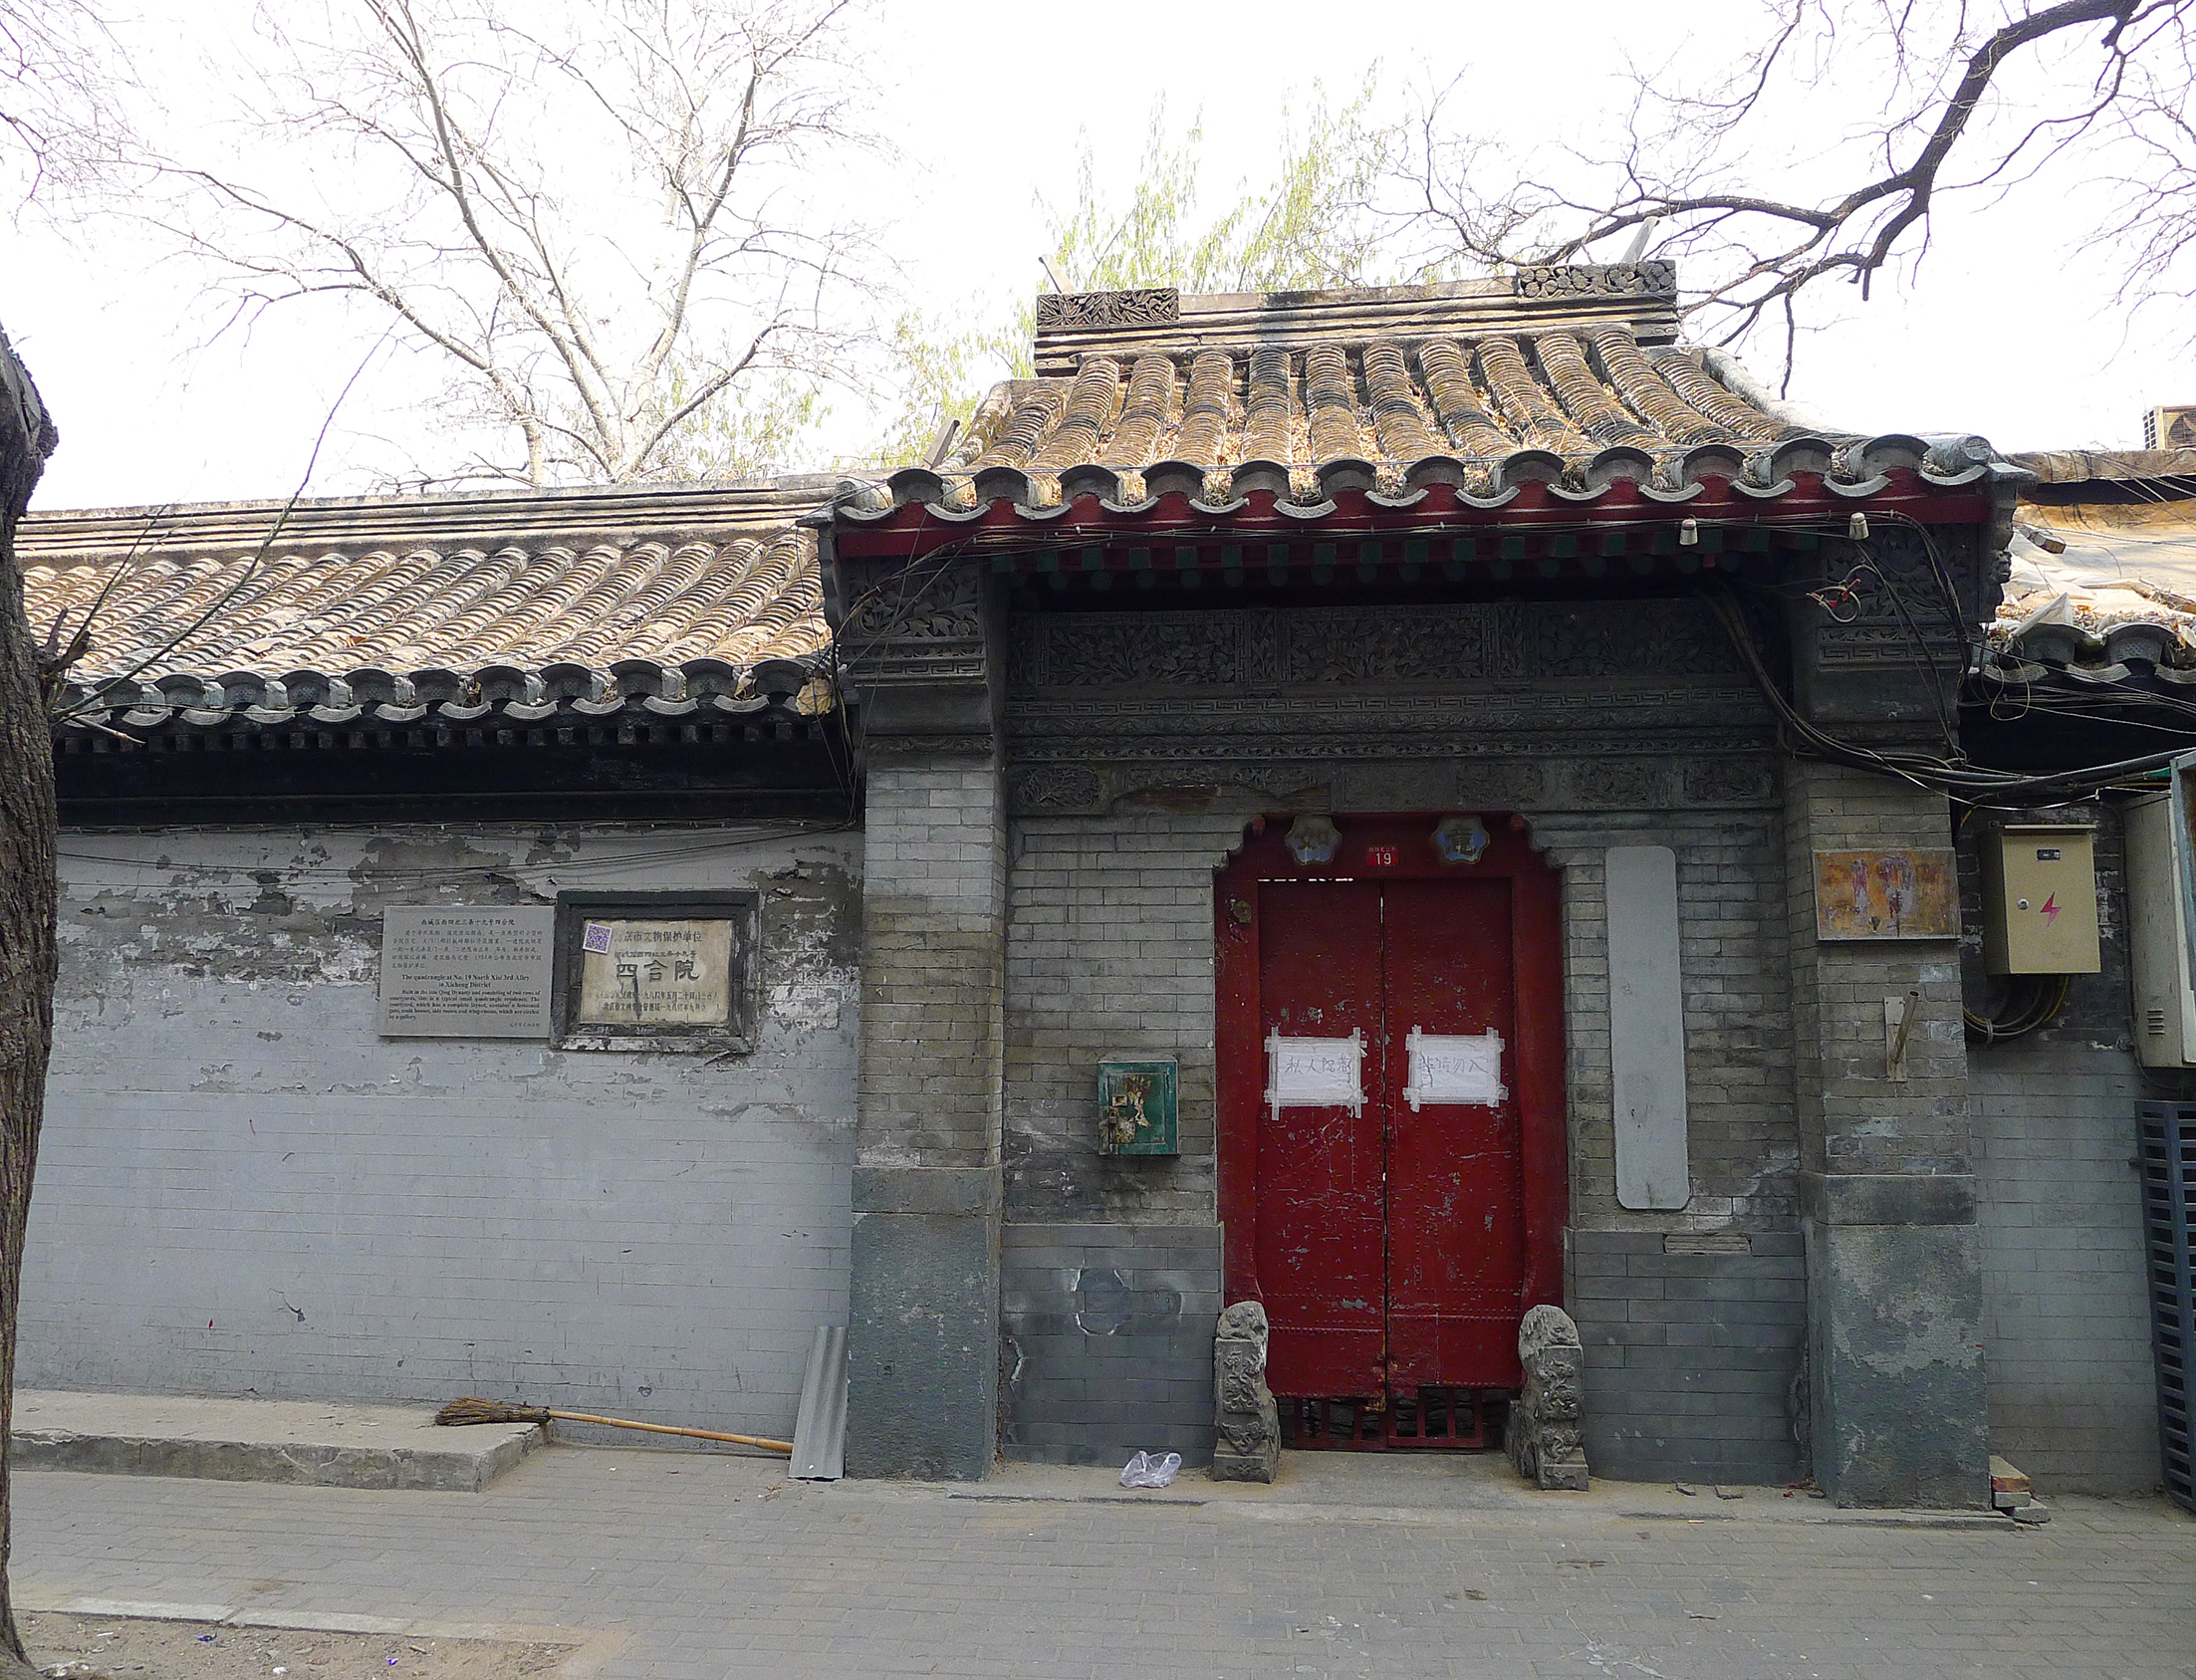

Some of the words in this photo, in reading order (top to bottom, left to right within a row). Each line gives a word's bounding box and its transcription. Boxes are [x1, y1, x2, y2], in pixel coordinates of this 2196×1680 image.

[1375, 852, 1391, 864] 19
[616, 959, 700, 982] 四合院
[1285, 1055, 1351, 1074] 私人院落
[1417, 1056, 1489, 1074] 非请勿入
